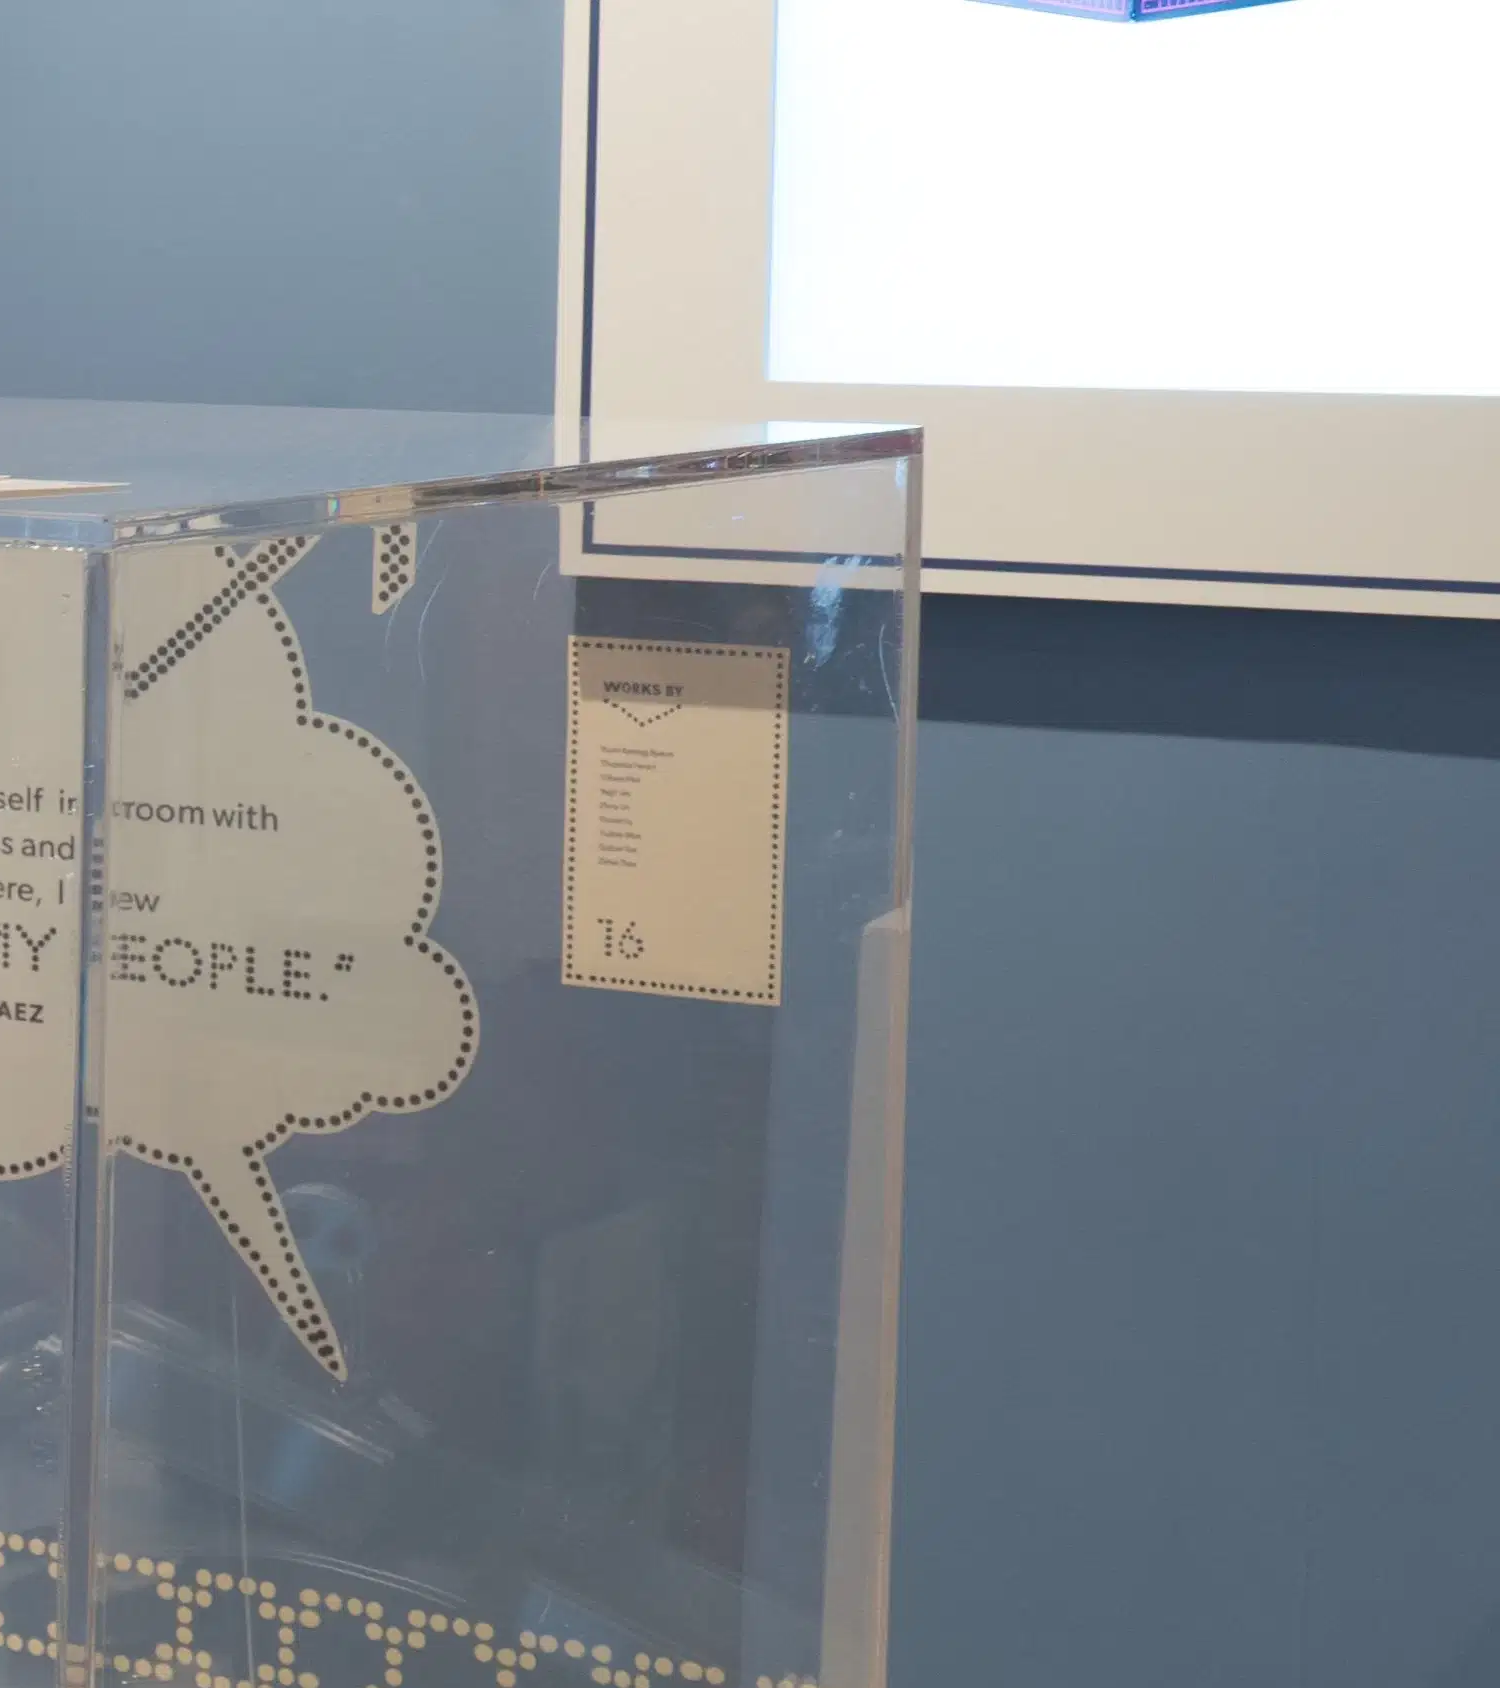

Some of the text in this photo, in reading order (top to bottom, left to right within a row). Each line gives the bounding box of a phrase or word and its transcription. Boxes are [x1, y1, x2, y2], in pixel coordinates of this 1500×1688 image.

[604, 681, 684, 698] WORKS BY
[212, 803, 279, 832] with
[21, 835, 75, 860] and
[59, 880, 64, 905] I
[111, 891, 160, 913] ew
[598, 918, 644, 959] 16
[110, 932, 354, 1002] EOPLE."
